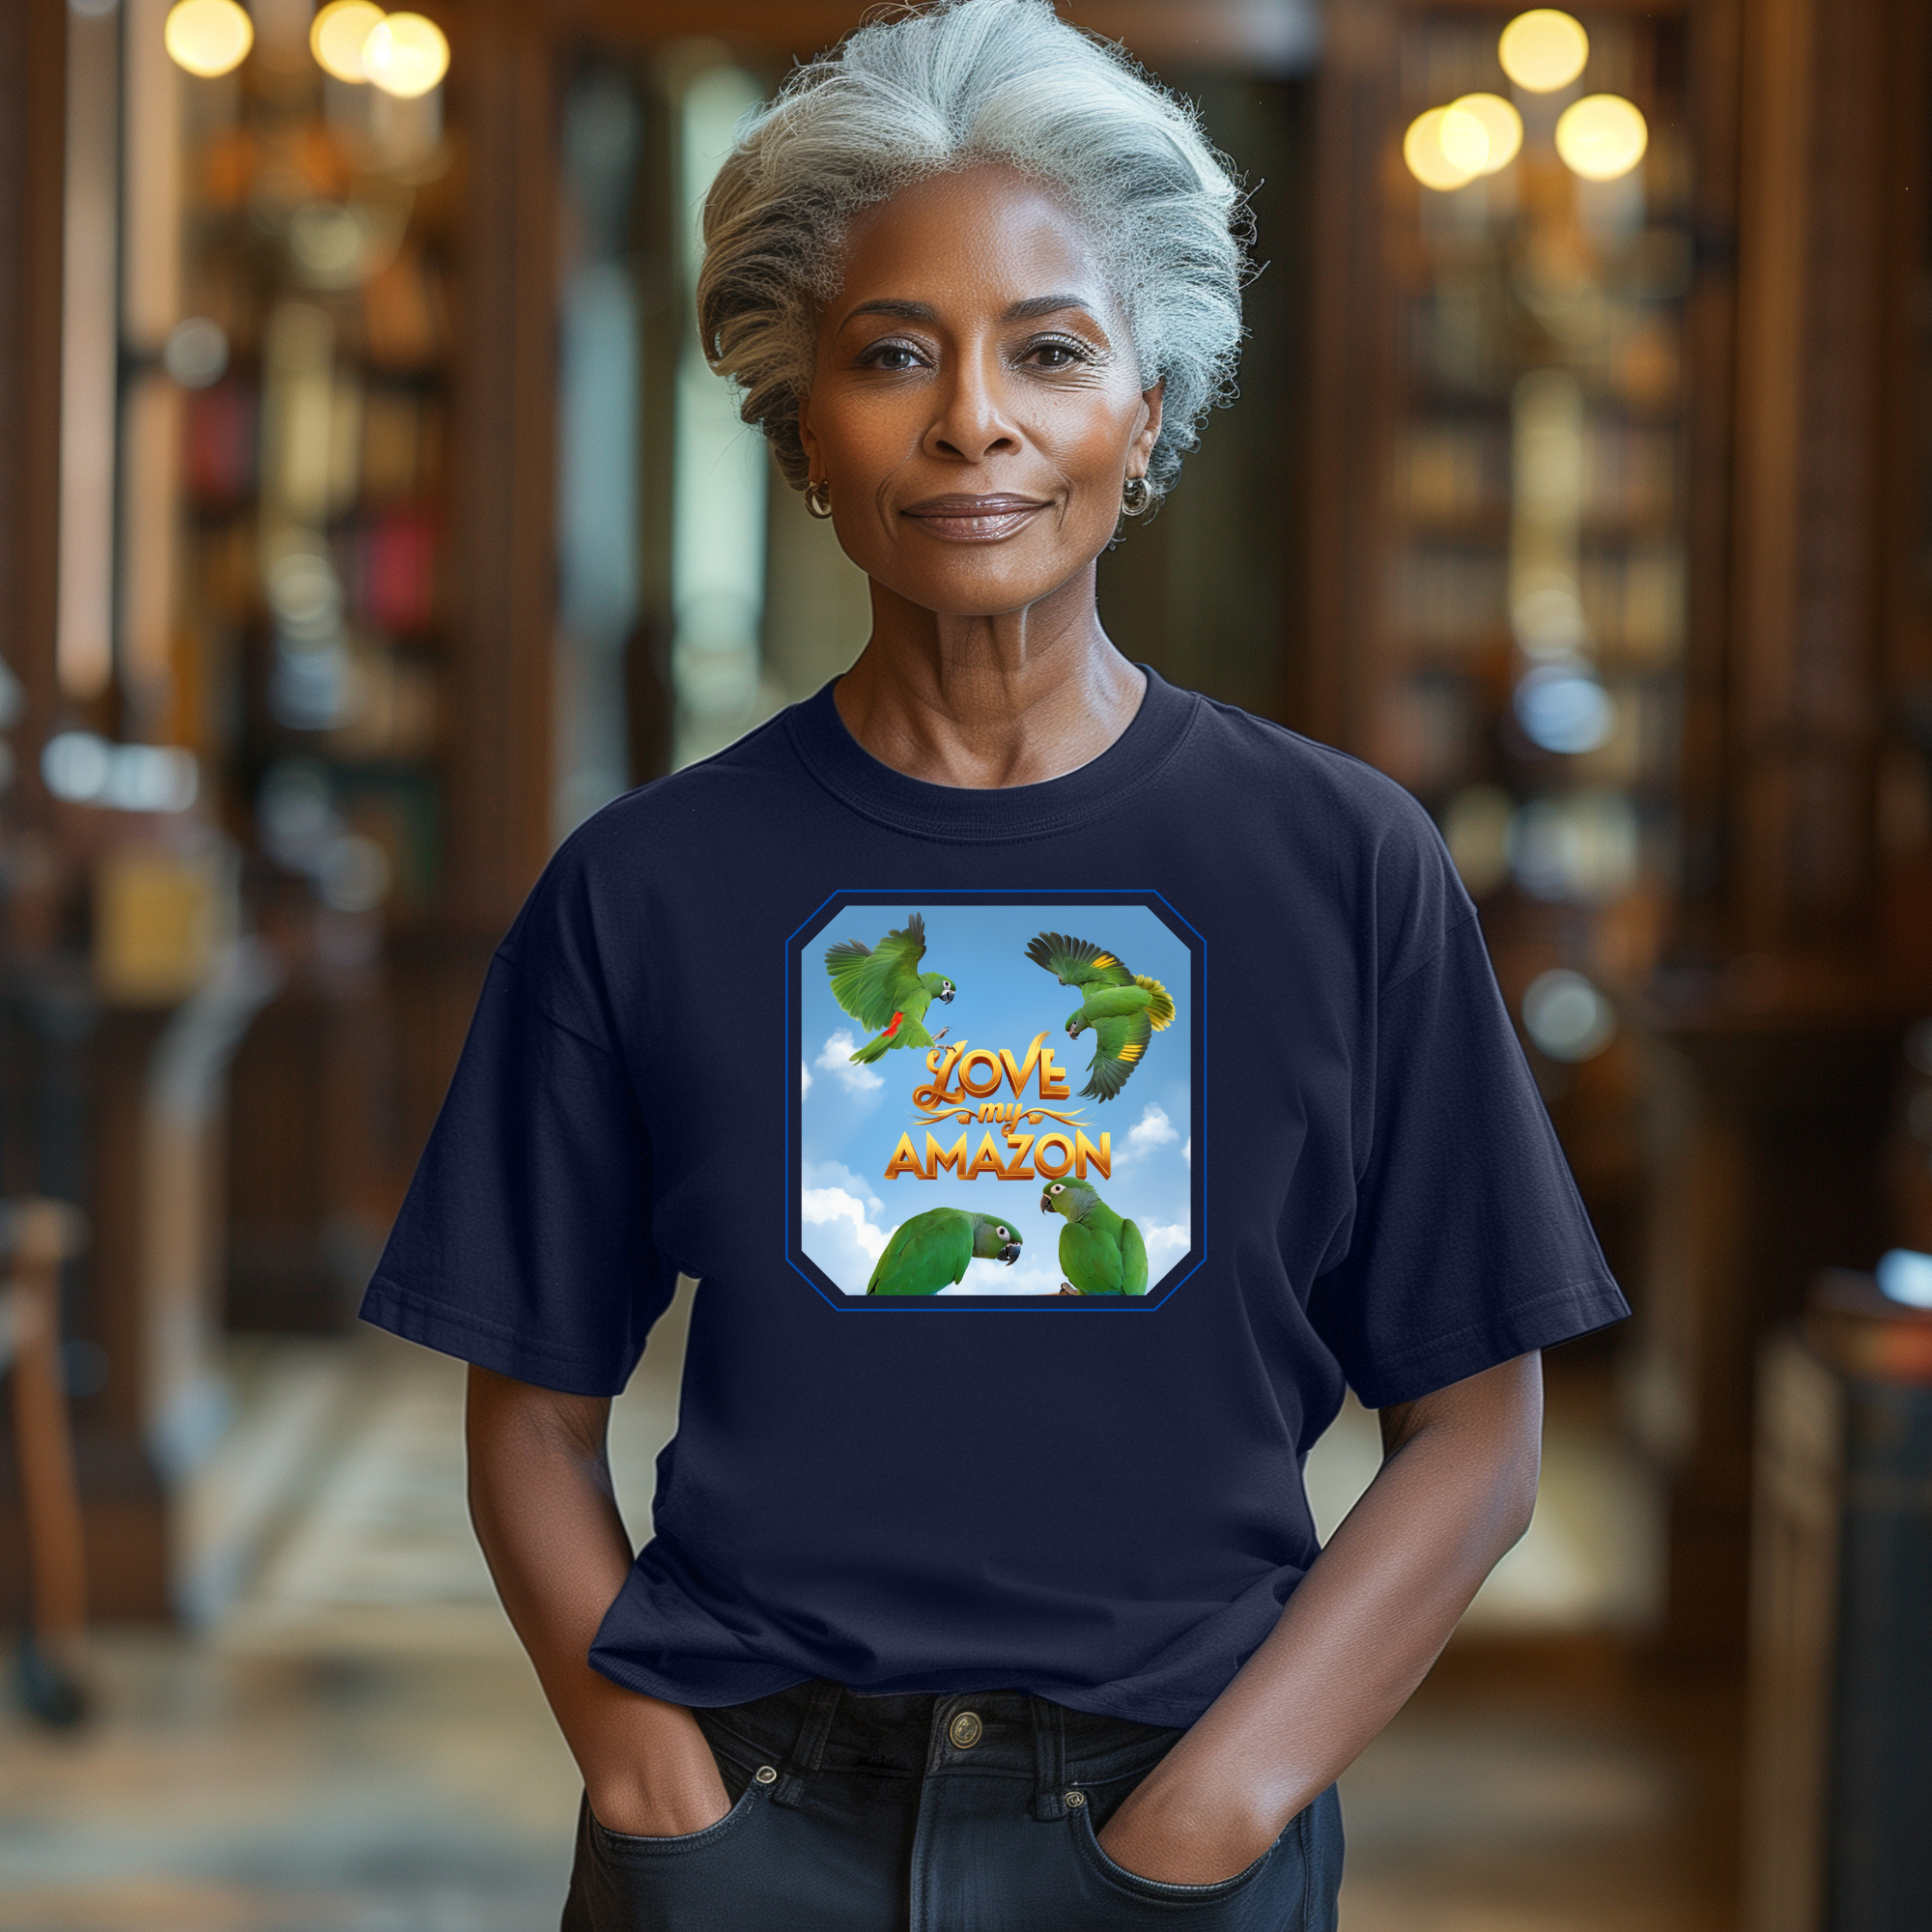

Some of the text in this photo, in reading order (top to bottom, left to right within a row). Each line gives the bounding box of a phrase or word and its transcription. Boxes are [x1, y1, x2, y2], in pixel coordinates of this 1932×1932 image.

[912, 1030, 1070, 1110] LOVE
[977, 1102, 1023, 1138] my
[883, 1128, 1112, 1180] AMAZON
